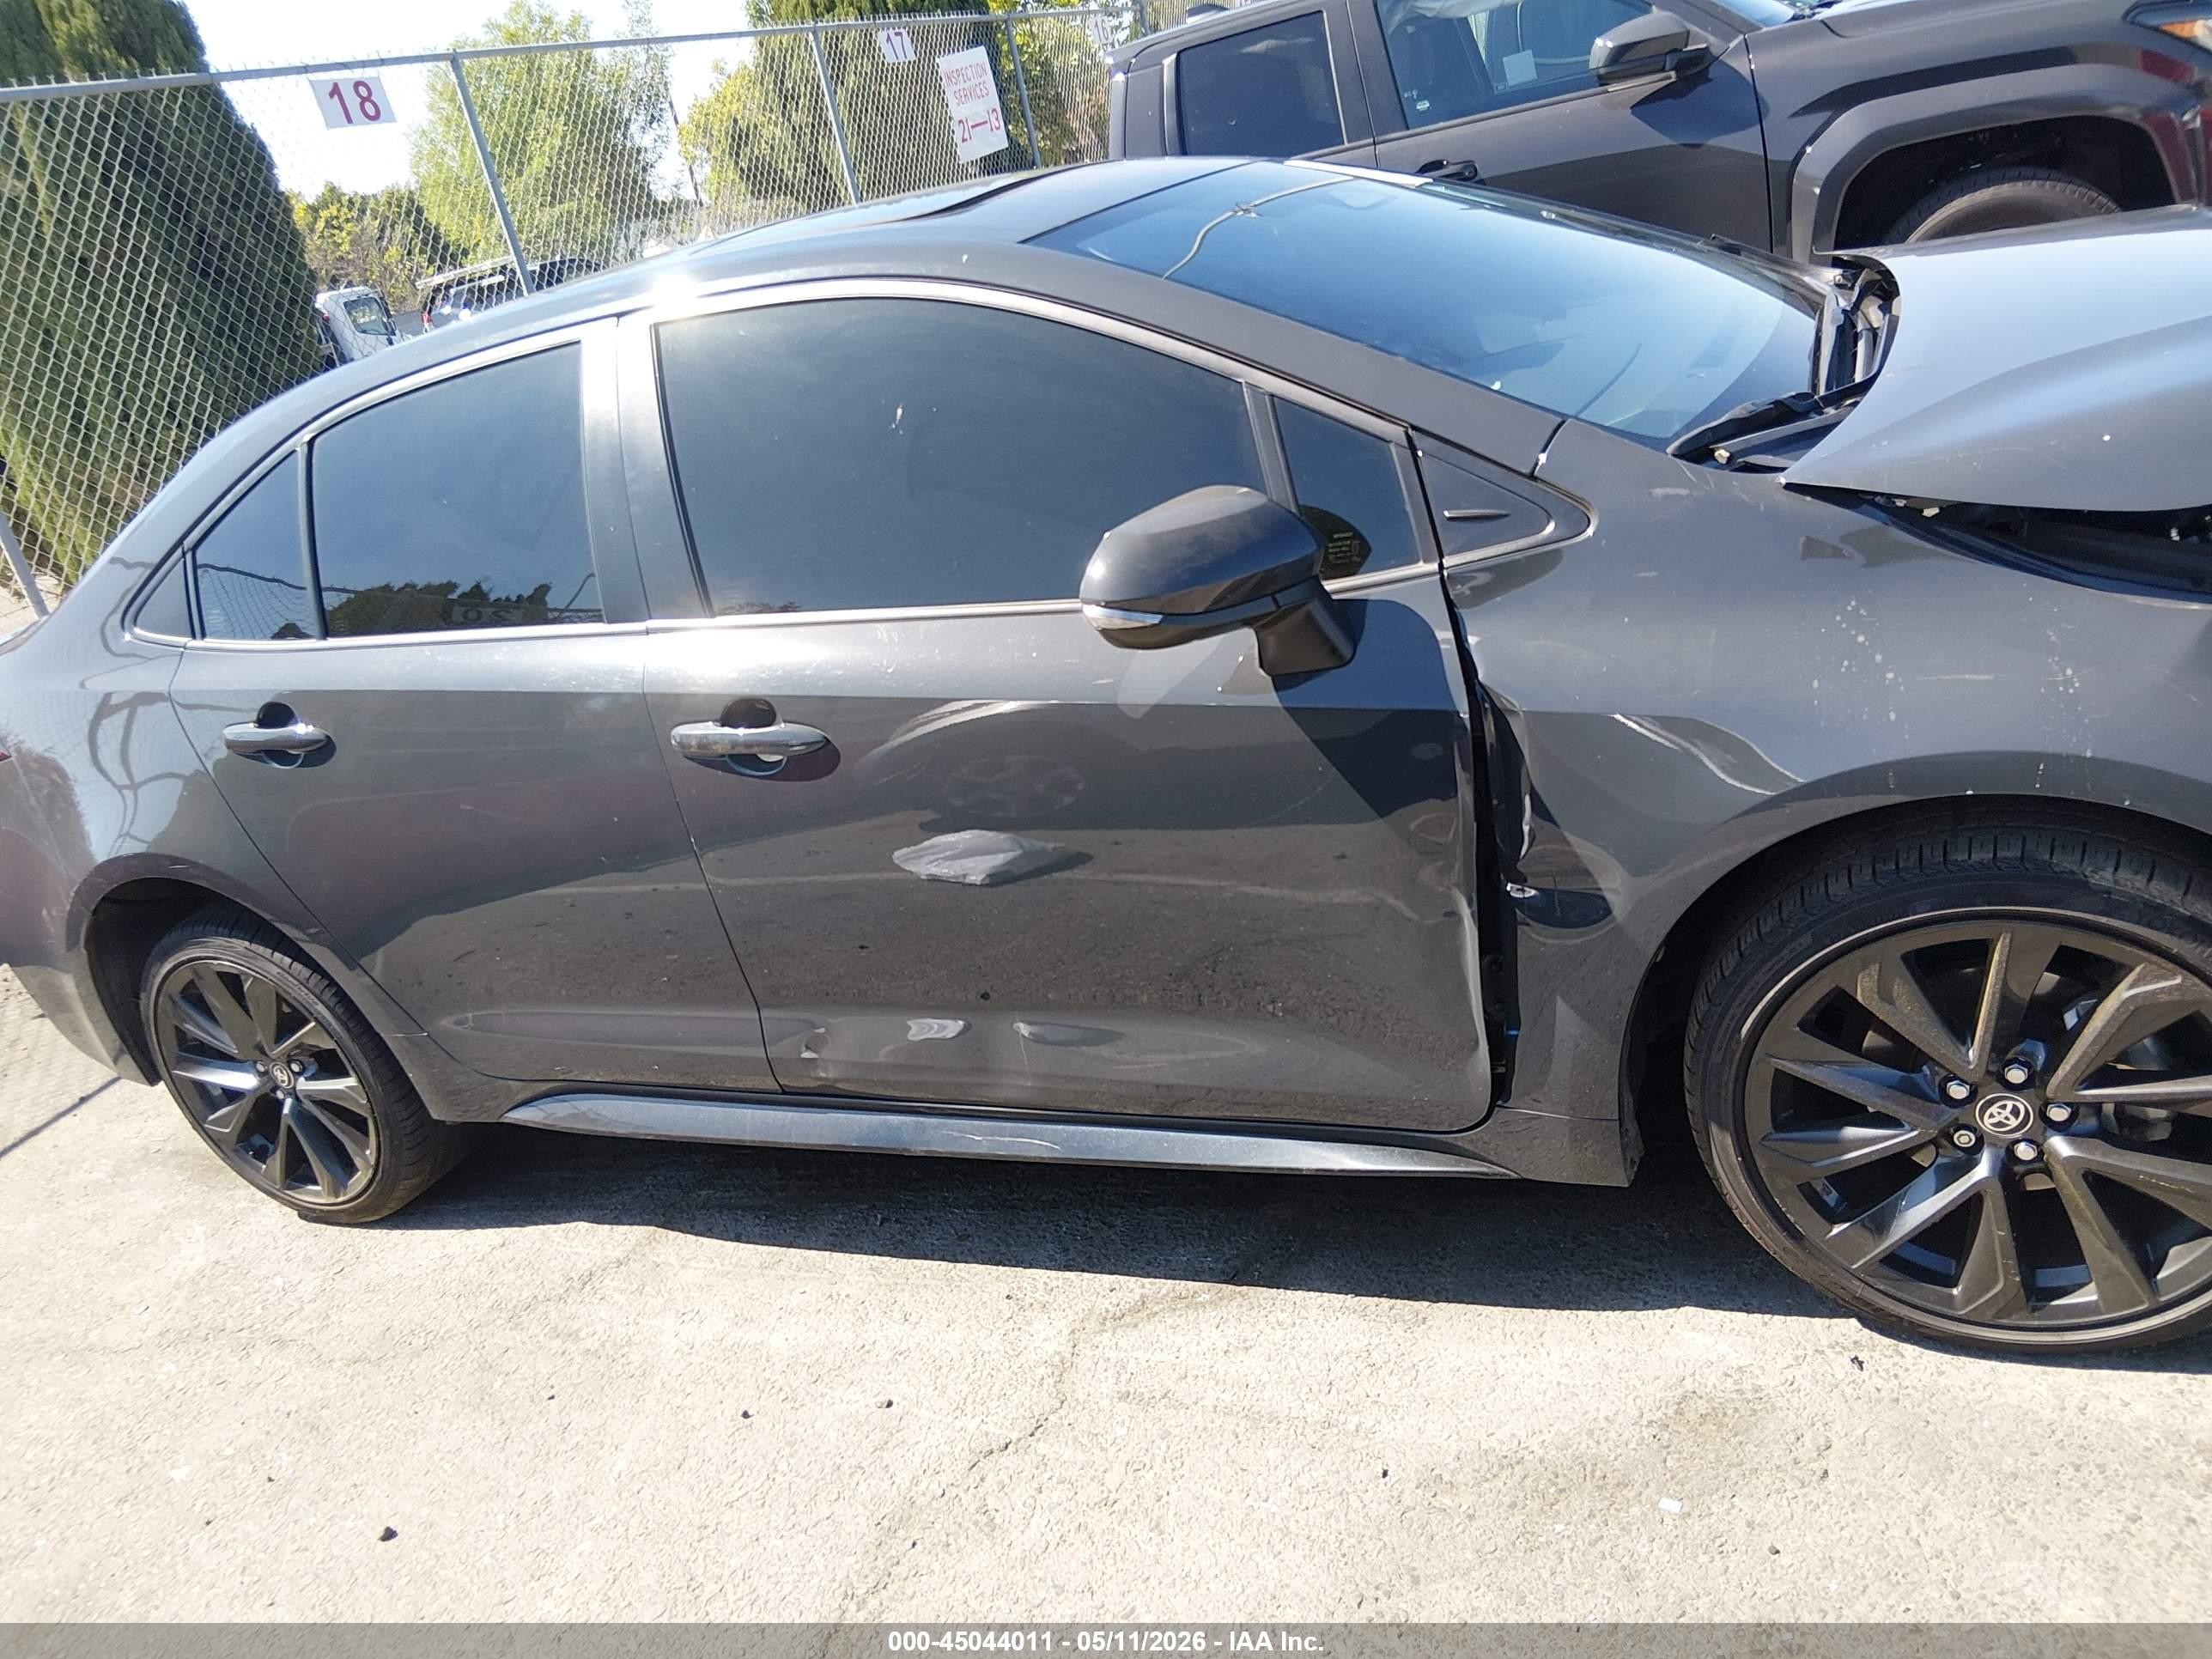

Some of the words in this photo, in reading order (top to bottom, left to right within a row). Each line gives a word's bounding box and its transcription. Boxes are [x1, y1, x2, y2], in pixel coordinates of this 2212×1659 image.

[1094, 18, 1109, 43] 16
[885, 31, 908, 60] 17
[944, 61, 988, 88] INSPECTION
[328, 80, 381, 125] 18
[953, 81, 990, 106] SERVICES
